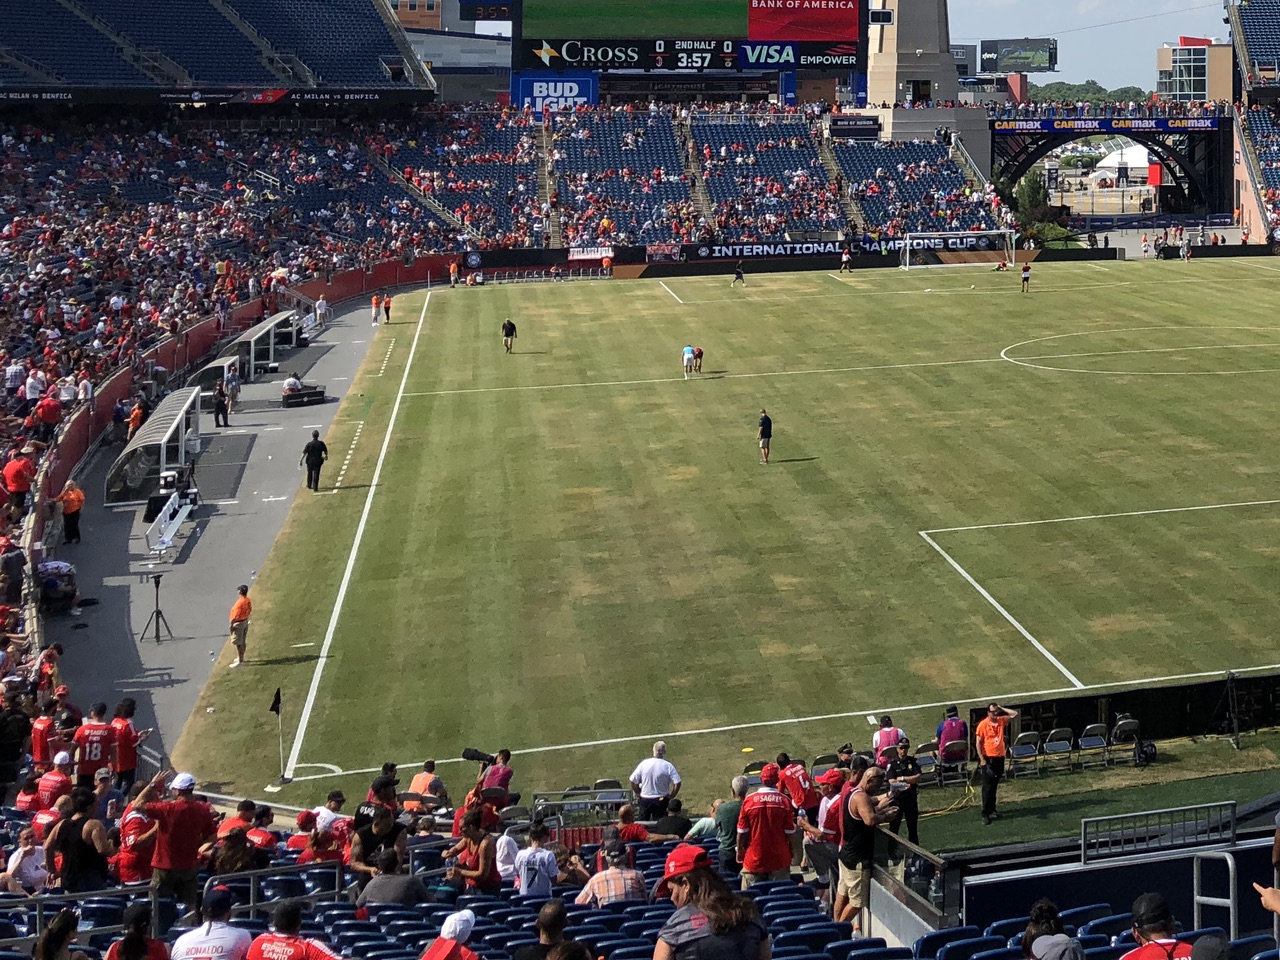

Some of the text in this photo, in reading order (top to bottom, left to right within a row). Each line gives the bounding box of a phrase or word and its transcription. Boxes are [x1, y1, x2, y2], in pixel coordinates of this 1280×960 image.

[752, 0, 854, 9] BANK OF AMERICA
[656, 40, 665, 53] 0
[675, 41, 716, 50] 2ND HALF
[724, 41, 732, 53] 0
[678, 53, 712, 67] 3:57
[741, 45, 795, 64] VISA
[800, 55, 857, 65] EMPOWER
[533, 82, 579, 97] BUD
[712, 238, 977, 257] INTERNATIONAL CHAMPIONS CUP
[85, 743, 102, 760] 18
[527, 867, 538, 888] 7
[186, 946, 224, 956] RONALDO
